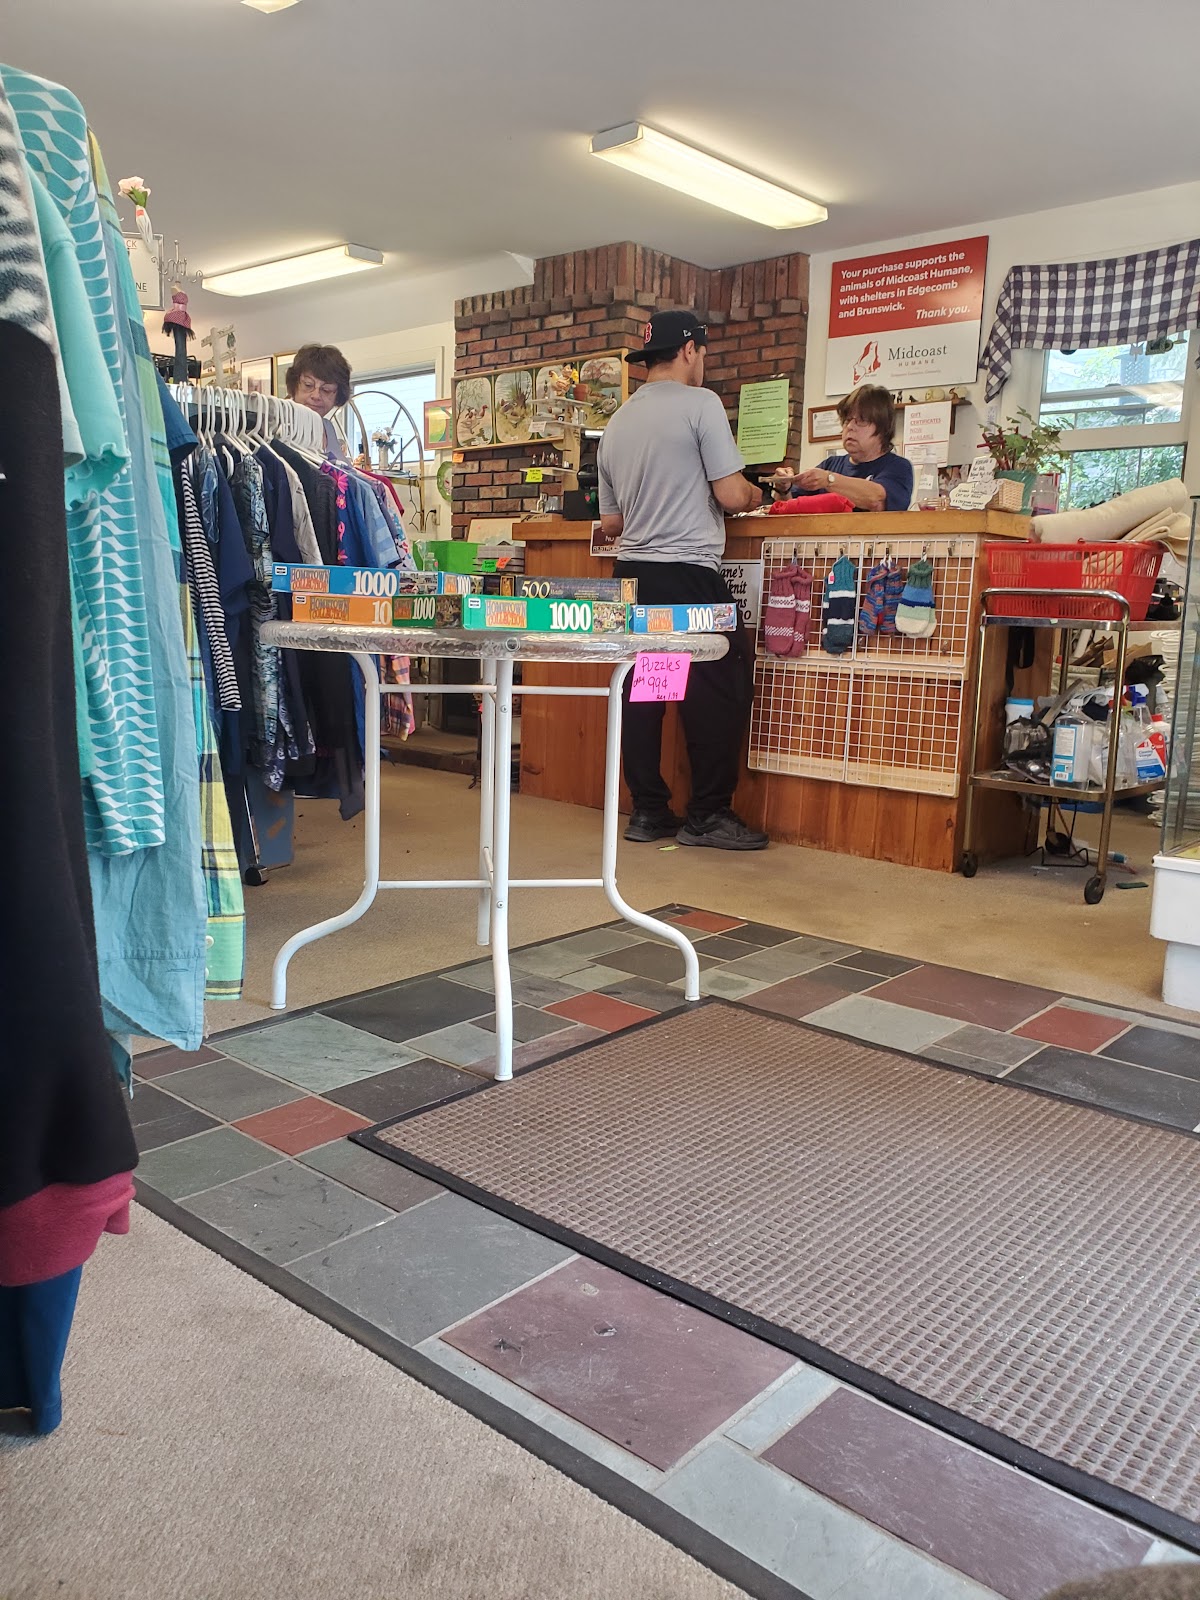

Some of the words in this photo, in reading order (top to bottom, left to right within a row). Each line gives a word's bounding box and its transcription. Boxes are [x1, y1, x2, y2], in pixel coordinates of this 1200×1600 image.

[126, 240, 137, 248] CK
[841, 270, 861, 279] Your
[862, 262, 903, 277] purchase
[905, 254, 947, 269] supports
[949, 251, 965, 262] the
[840, 279, 874, 292] animals
[875, 277, 886, 287] of
[886, 270, 928, 285] Midcoast
[929, 264, 974, 279] Humane,
[839, 294, 858, 305] with
[860, 288, 895, 303] shelters
[896, 286, 905, 297] in
[907, 280, 958, 296] Edgecomb
[838, 308, 855, 318] and
[857, 302, 906, 316] Brunswick.
[916, 306, 946, 320] Thank
[948, 305, 970, 317] you.
[888, 345, 947, 360] Midcoast
[291, 569, 330, 583] HOMETOWN
[720, 565, 744, 578] ane's
[291, 578, 329, 592] COLLECTION
[353, 570, 397, 596] 1000
[522, 581, 550, 599] 500
[412, 597, 435, 620] 1000
[486, 601, 526, 616] HOMETOWN
[550, 602, 592, 631] 1000
[488, 611, 525, 627] COLLECTION
[687, 607, 713, 630] 1000
[641, 656, 681, 672] Puzzles
[648, 676, 668, 693] 99¢
